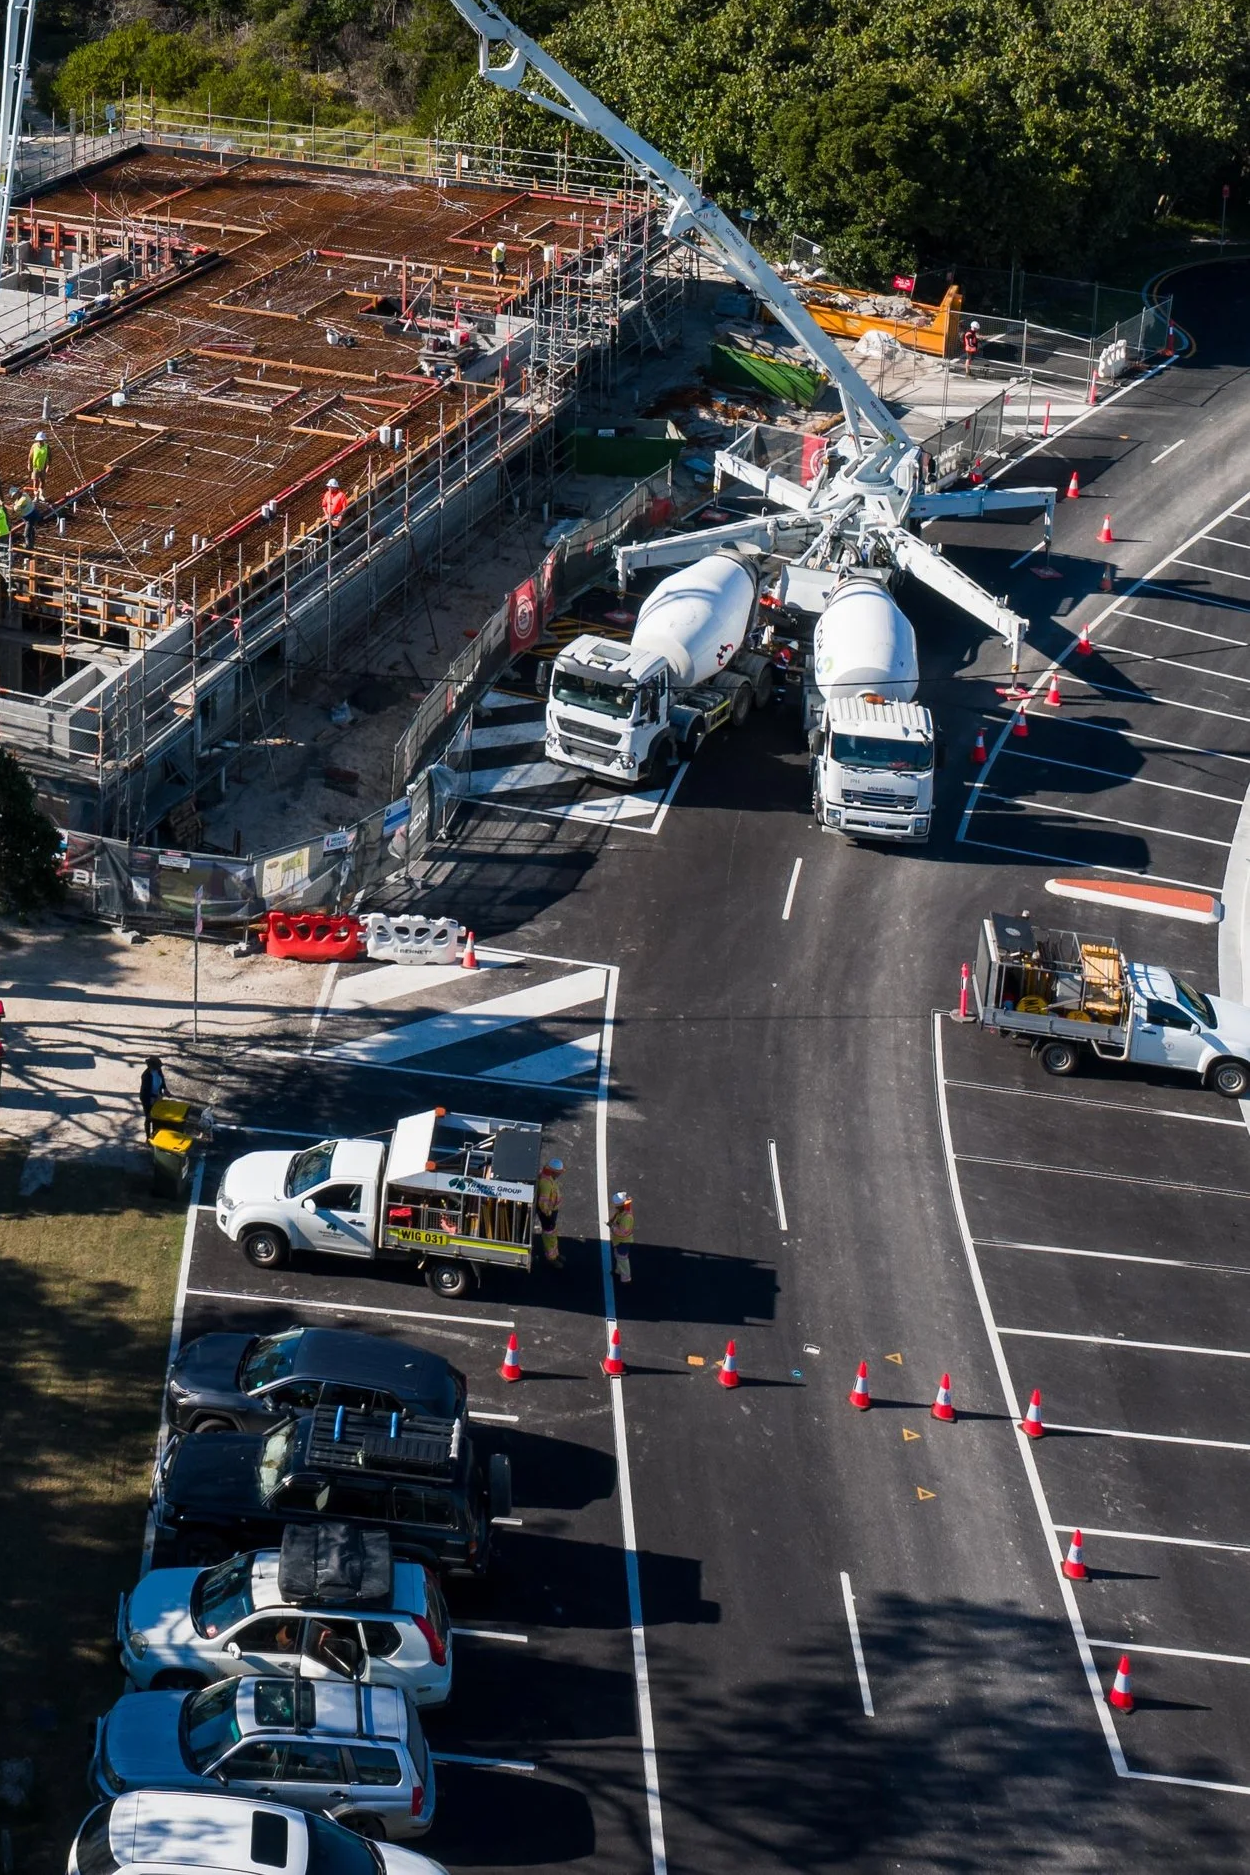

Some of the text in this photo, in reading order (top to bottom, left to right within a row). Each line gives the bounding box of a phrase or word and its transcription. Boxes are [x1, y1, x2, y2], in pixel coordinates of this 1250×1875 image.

[467, 1180, 522, 1195] TRAFFIC GROUP
[467, 1187, 502, 1197] AUSTRALIA
[401, 1229, 443, 1245] WIG 031
